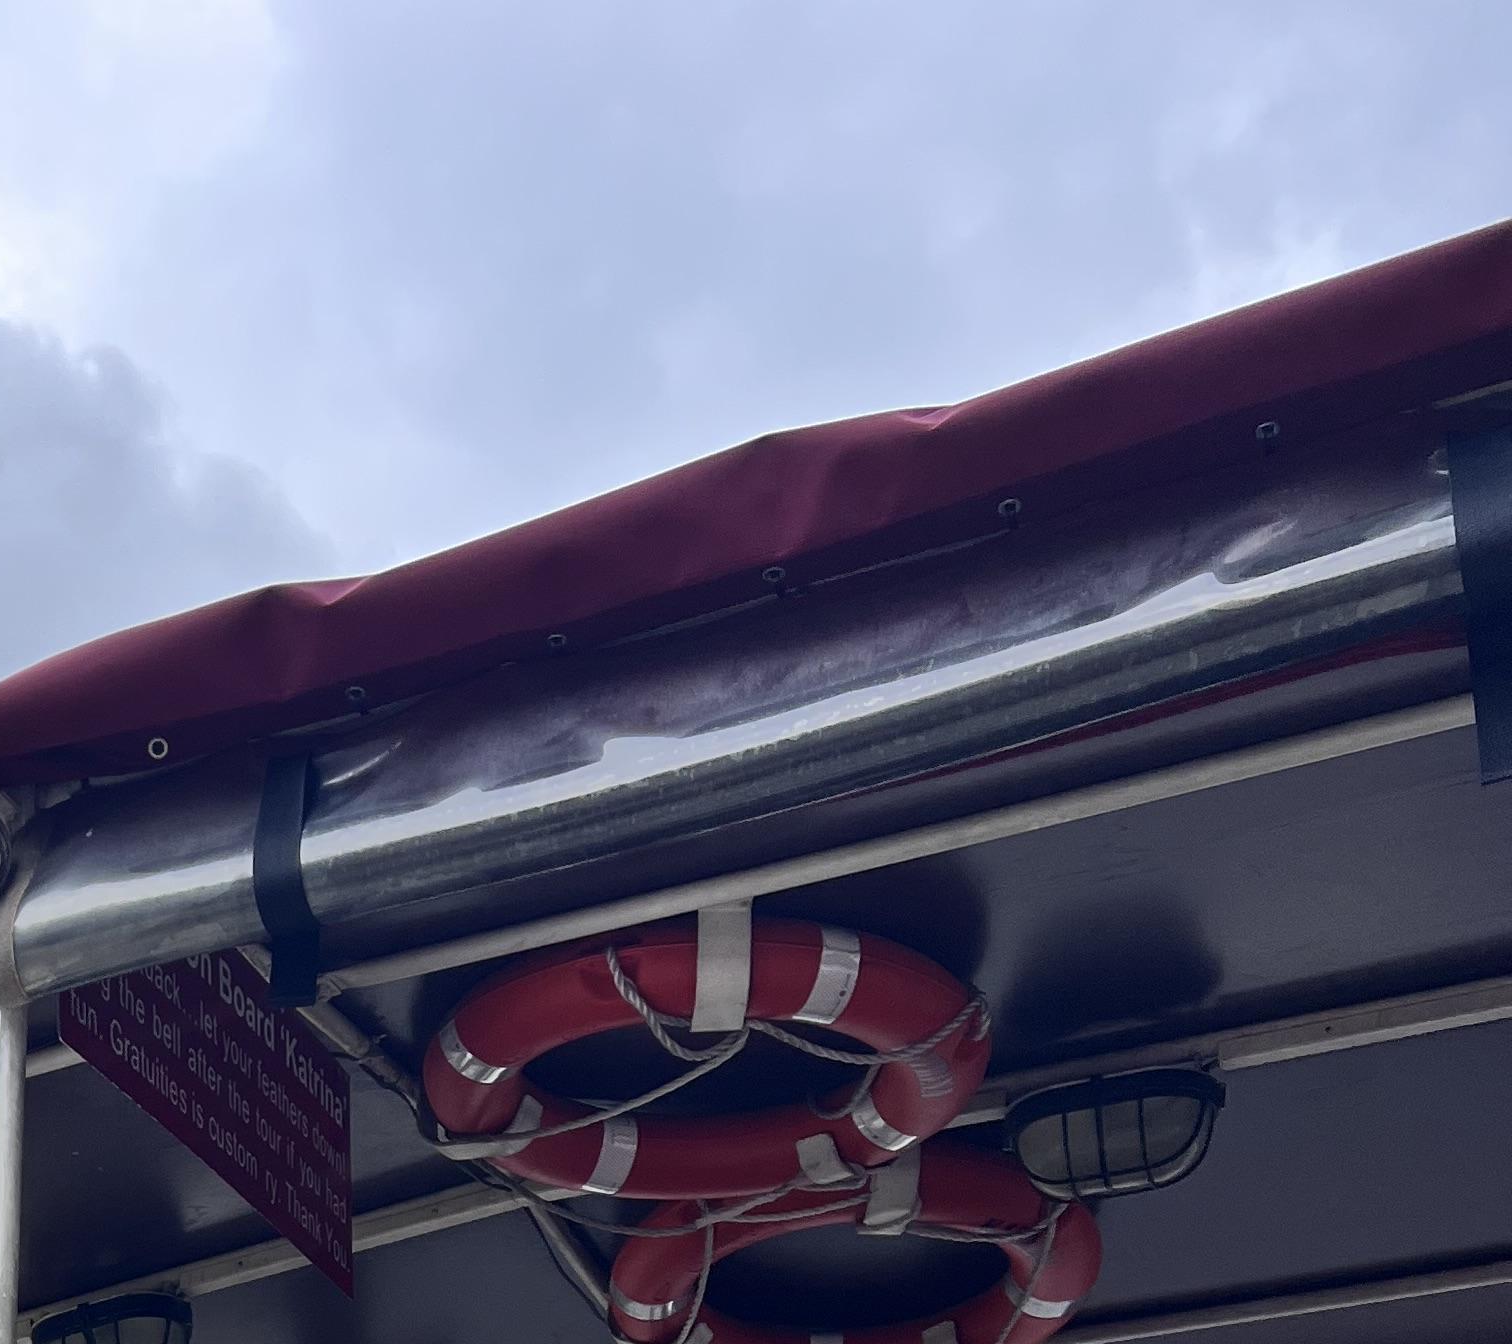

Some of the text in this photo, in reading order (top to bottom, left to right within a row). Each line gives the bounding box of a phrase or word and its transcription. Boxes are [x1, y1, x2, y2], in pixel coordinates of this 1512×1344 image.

[119, 975, 145, 1025] the
[152, 1004, 181, 1059] bell
[189, 1047, 222, 1096] after
[228, 1079, 251, 1124] the
[256, 1107, 282, 1155] tour
[286, 1136, 295, 1168] if
[299, 1157, 321, 1196] you
[326, 1178, 347, 1224] had
[219, 959, 275, 1051] Board
[110, 1018, 187, 1114] Gratuities
[191, 1092, 204, 1129] is
[285, 1180, 323, 1245] Thank
[325, 1223, 351, 1273] You.
[223, 1032, 252, 1079] your
[257, 1060, 309, 1138] feathers
[312, 1125, 347, 1180] down!
